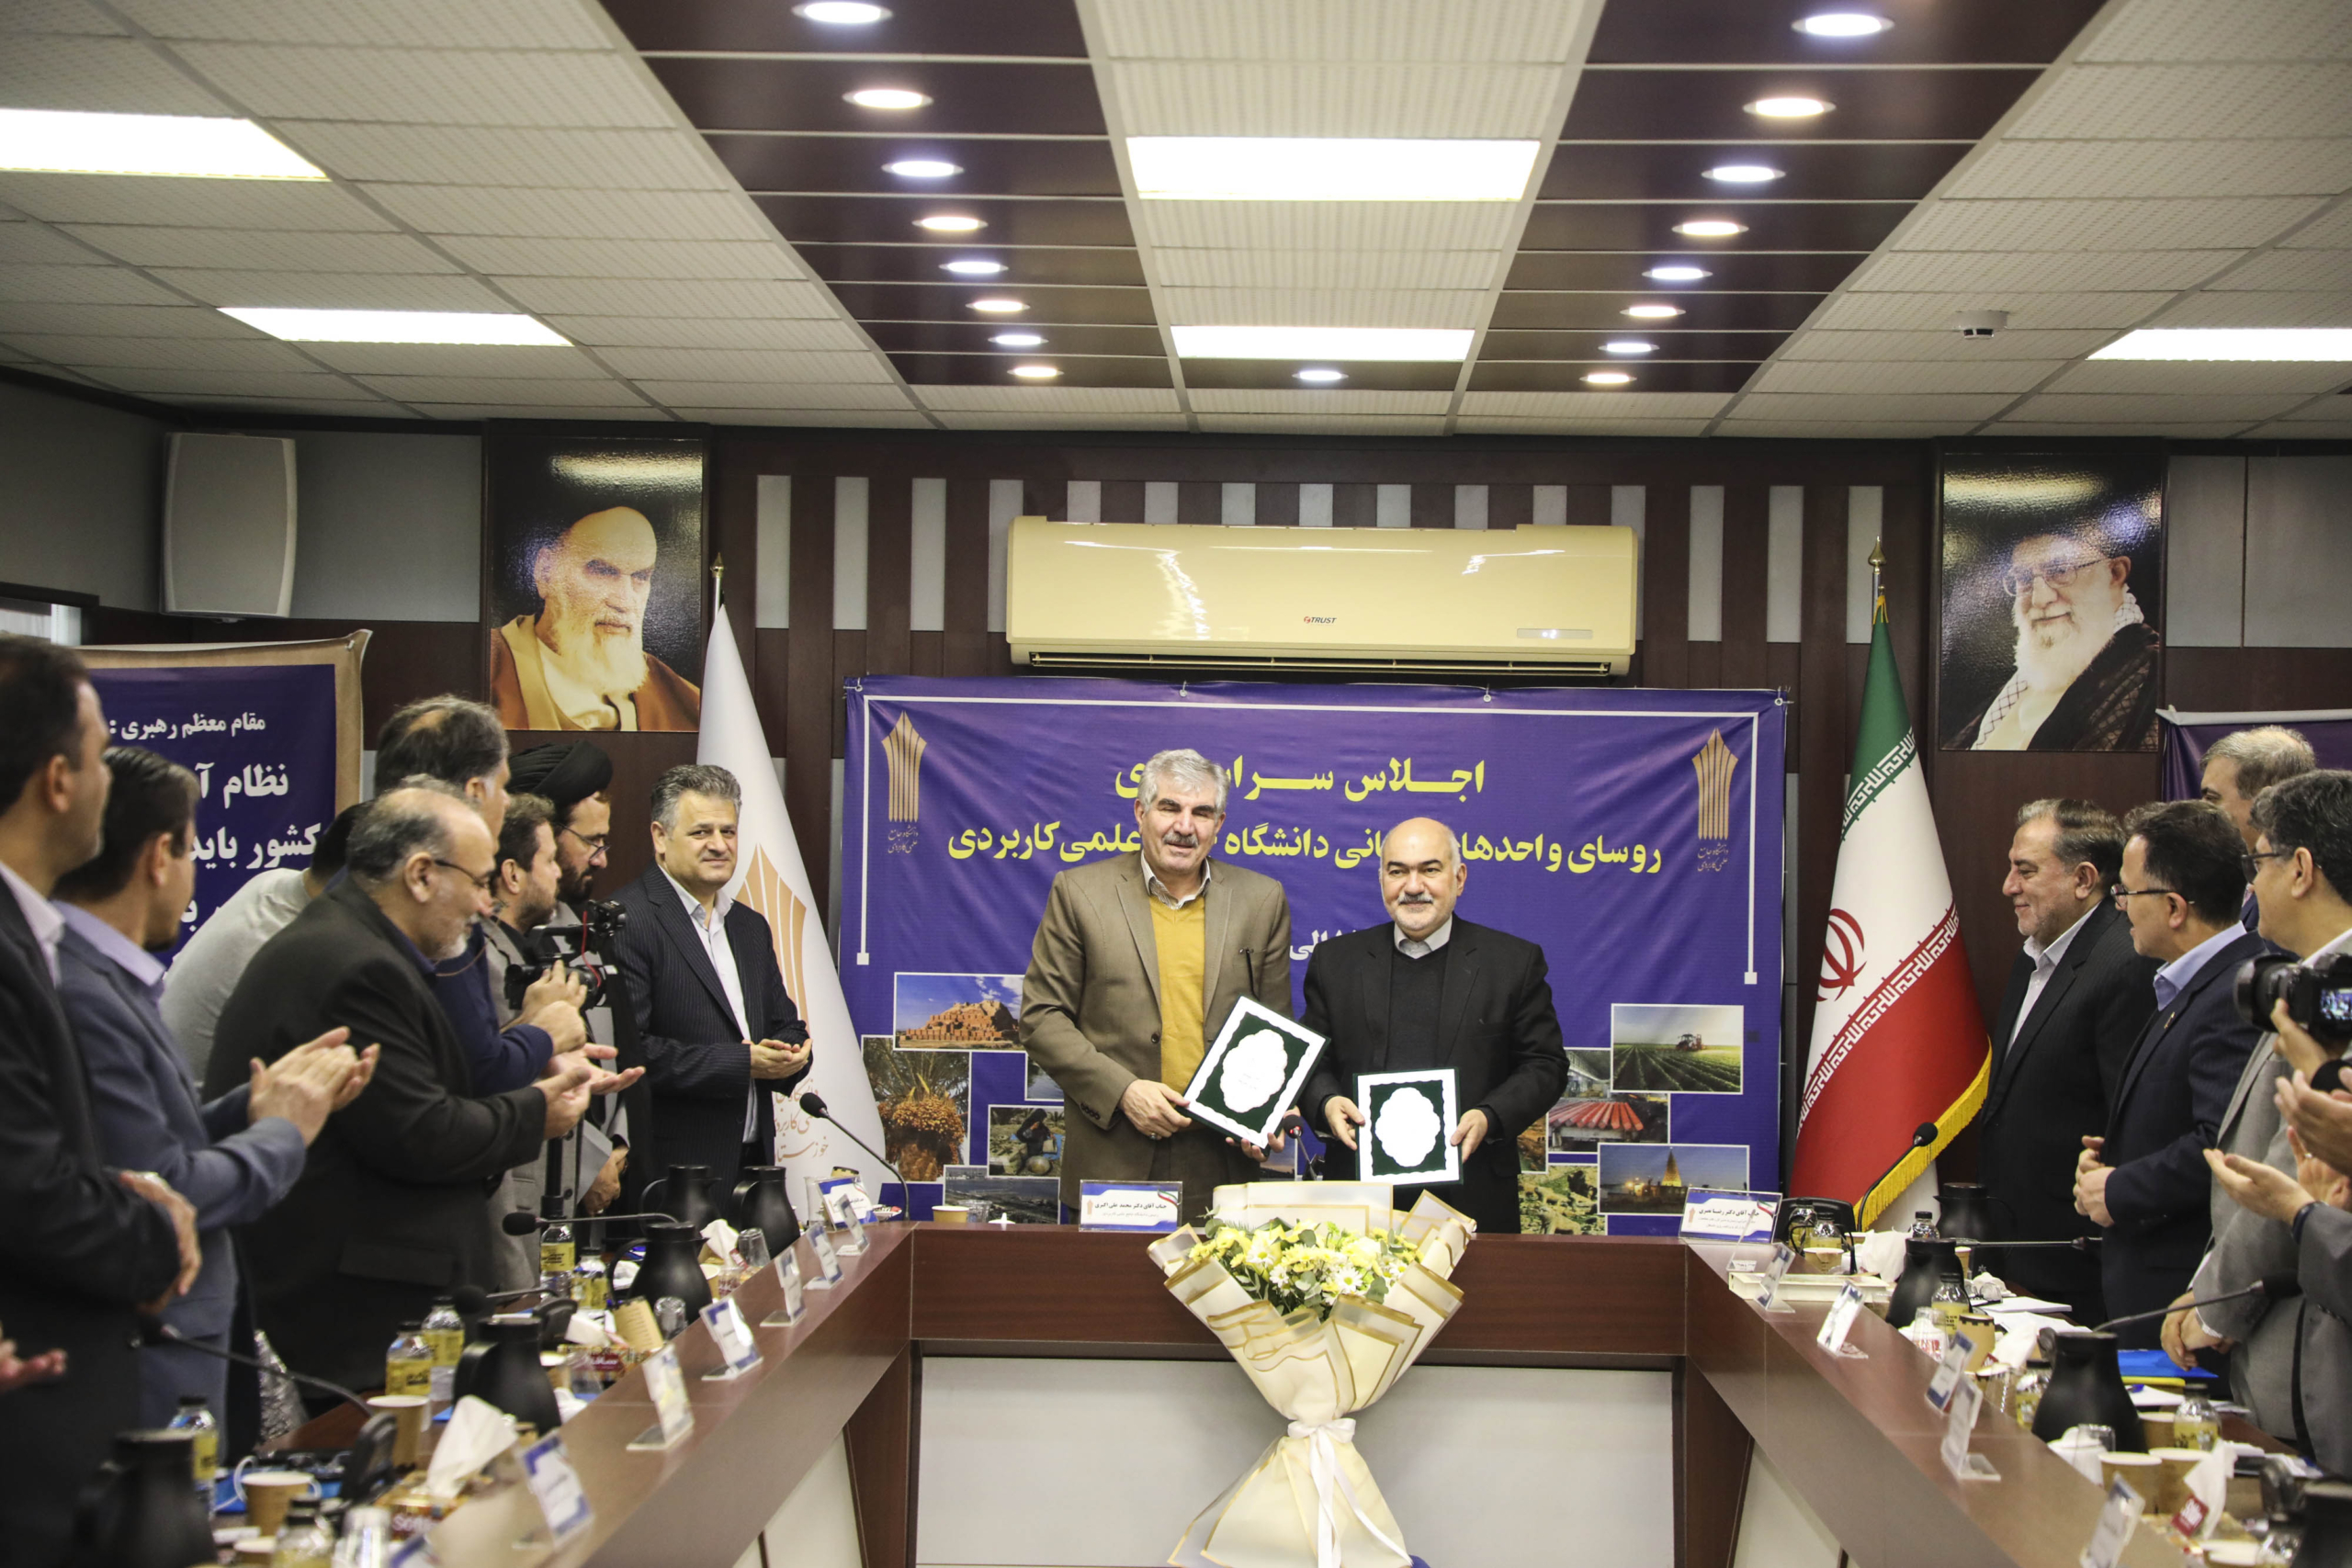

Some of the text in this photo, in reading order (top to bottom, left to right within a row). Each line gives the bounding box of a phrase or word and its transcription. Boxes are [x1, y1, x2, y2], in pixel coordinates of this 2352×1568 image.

[121, 718, 177, 740] رهبری
[182, 713, 227, 738] معظم
[231, 712, 266, 737] مقام
[223, 763, 288, 809] نظام
[1344, 757, 1485, 803] اجلاس
[246, 823, 322, 869] کشور
[948, 821, 1061, 860] کاربردی
[1059, 823, 1142, 863] علمی
[1225, 822, 1329, 858] دانشگاه
[1457, 832, 1562, 872] واحدها
[1567, 835, 1662, 874] روسای
[775, 1136, 828, 1162] خوزستا
